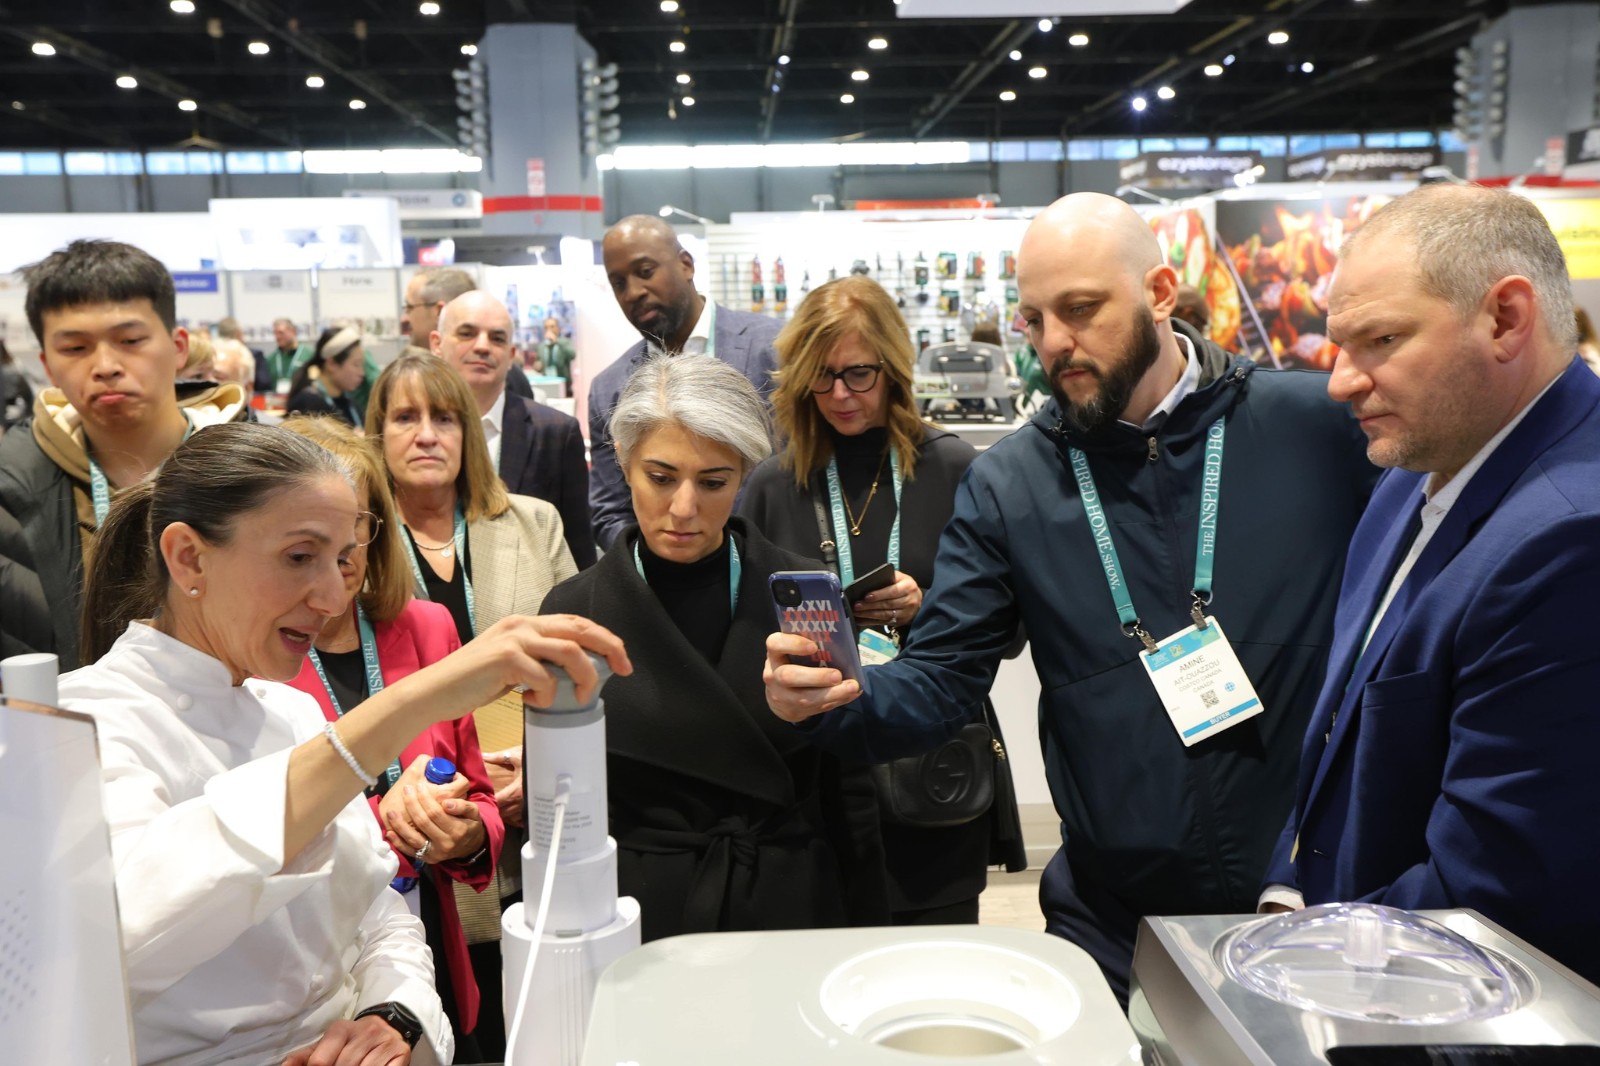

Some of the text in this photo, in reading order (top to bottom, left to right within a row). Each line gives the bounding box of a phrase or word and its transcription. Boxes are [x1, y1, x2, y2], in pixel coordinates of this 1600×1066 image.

[1200, 453, 1221, 529] INSPIRED
[833, 503, 849, 556] INSPIRED
[1086, 503, 1114, 553] HOME
[1202, 530, 1214, 556] THE
[842, 556, 852, 574] THE
[790, 620, 839, 633] XXXIX
[362, 640, 376, 663] THE
[1179, 655, 1205, 673] AMINE
